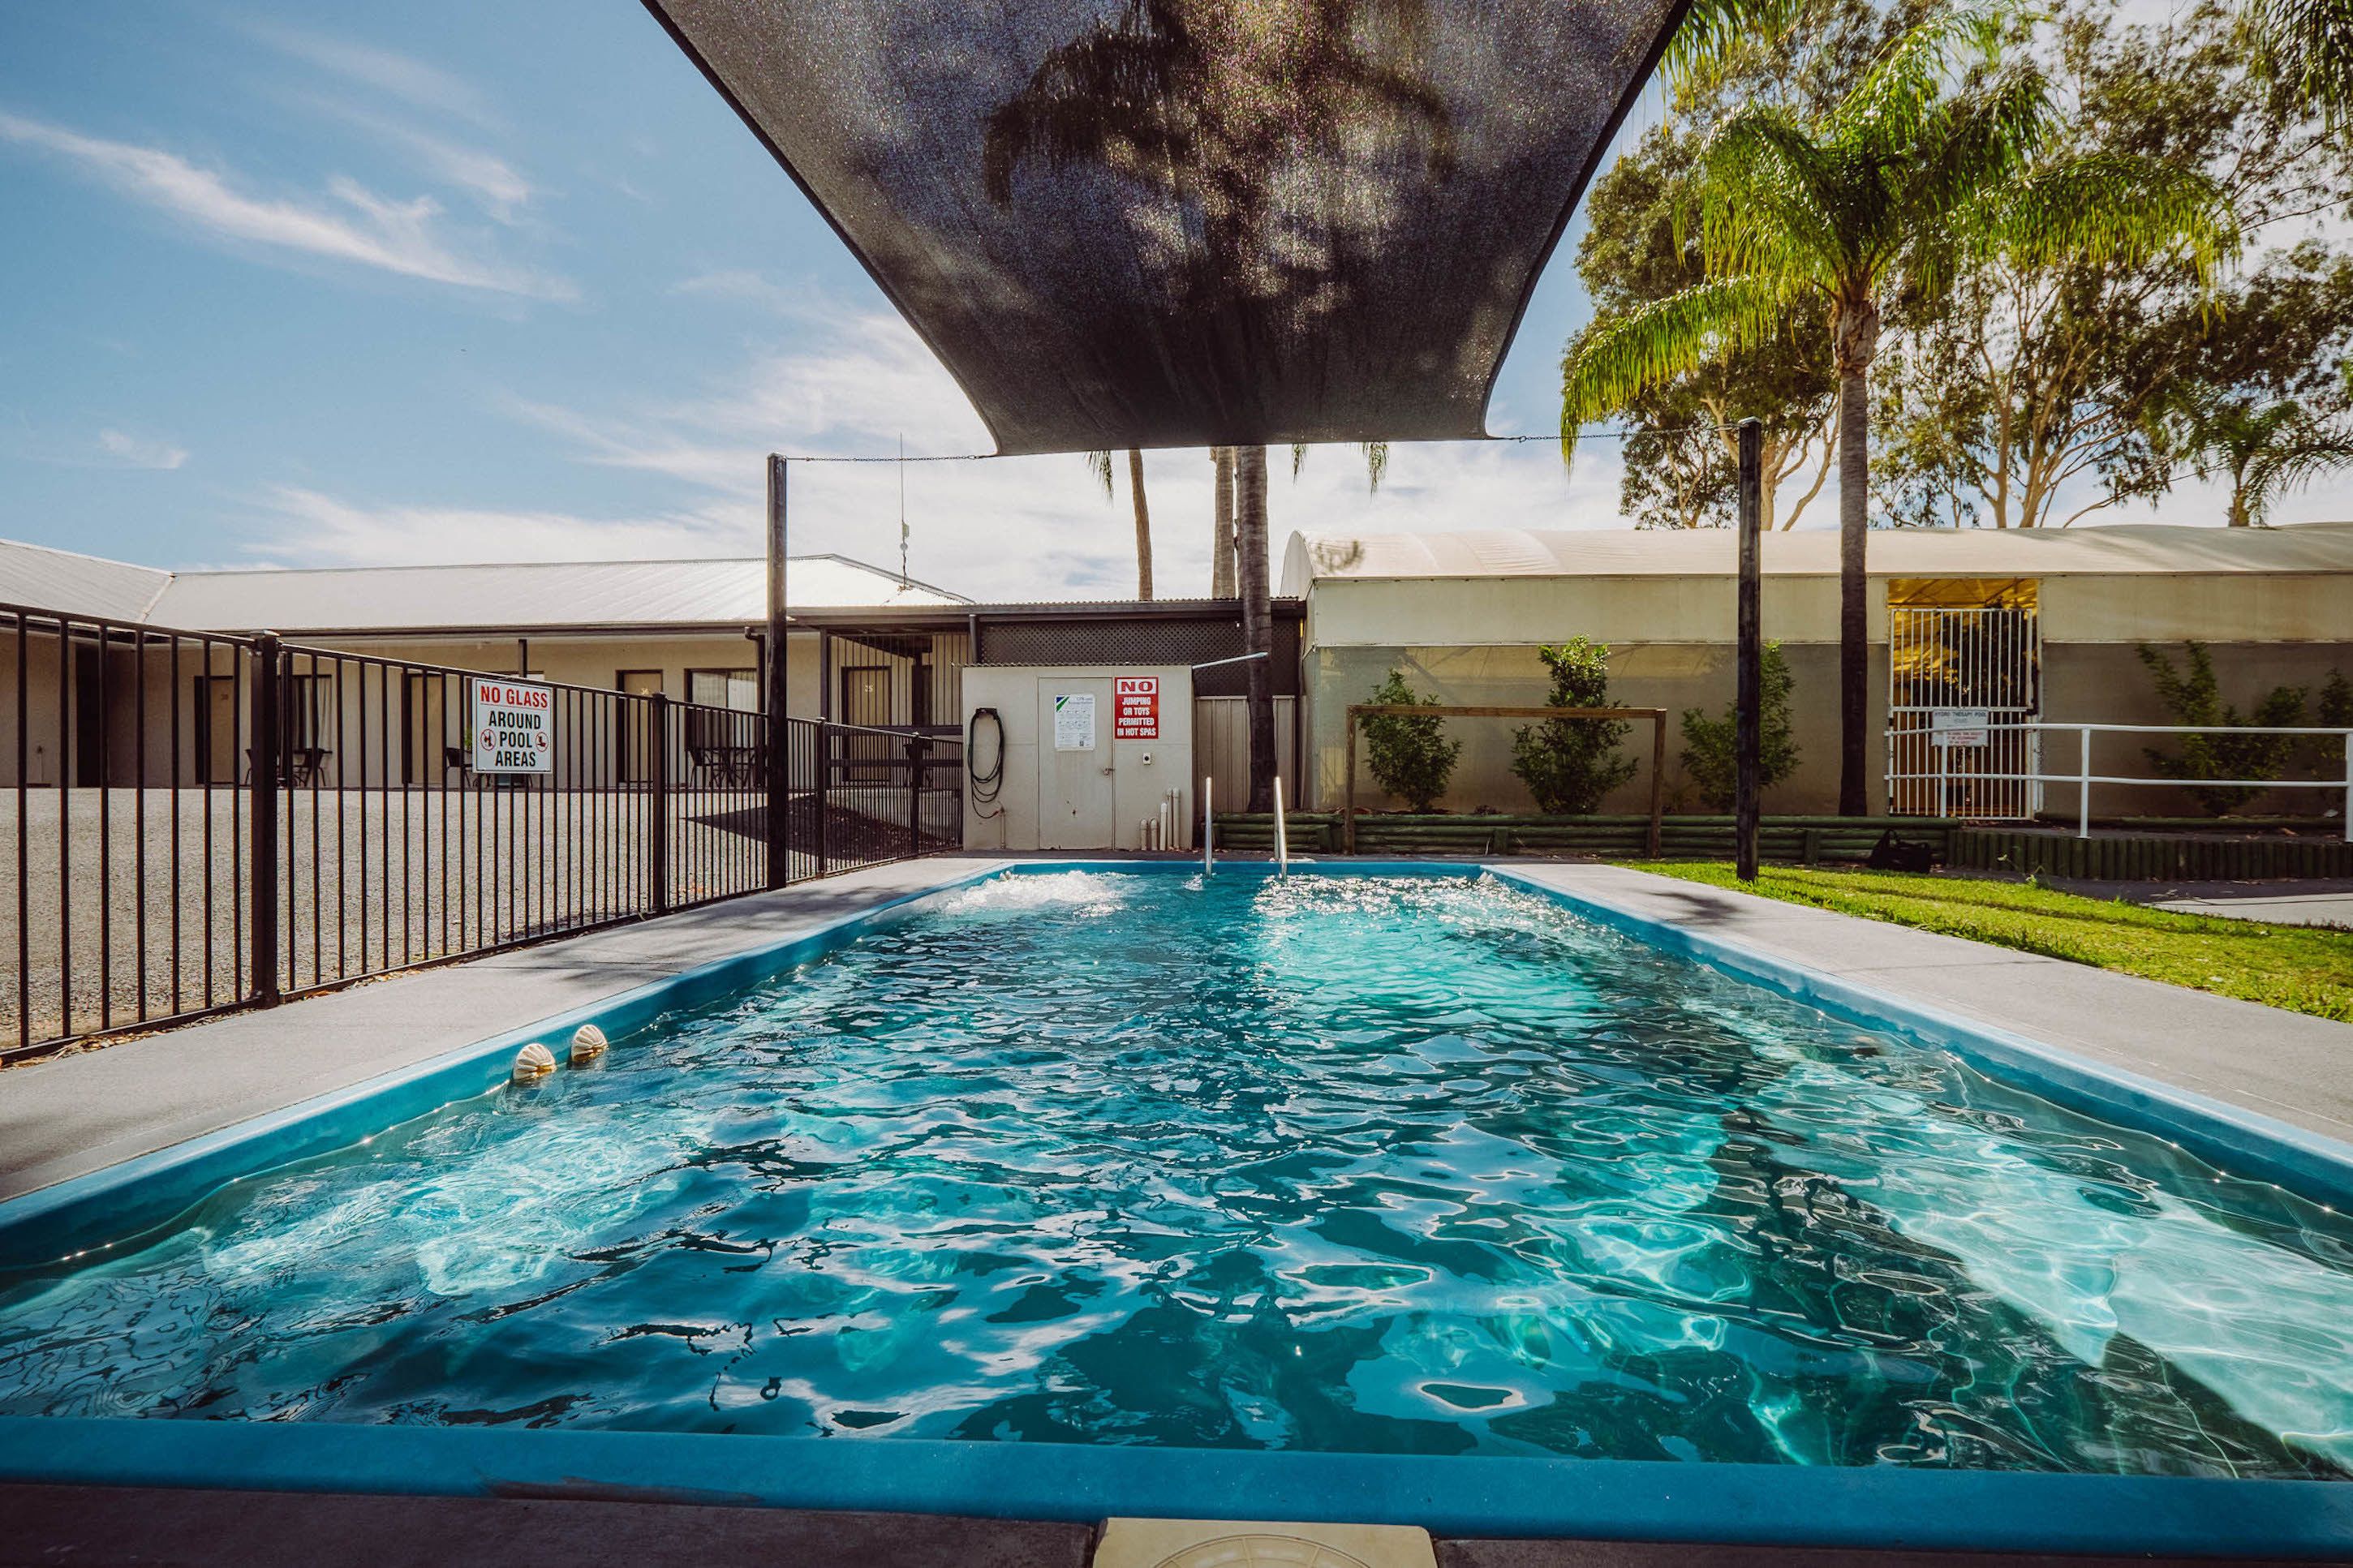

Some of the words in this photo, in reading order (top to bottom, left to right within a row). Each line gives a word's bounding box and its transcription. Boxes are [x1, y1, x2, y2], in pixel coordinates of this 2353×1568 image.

[1121, 681, 1153, 692] NO
[480, 685, 501, 703] NO
[506, 688, 548, 708] GLASS
[1122, 697, 1151, 705] JUMPING
[1123, 707, 1133, 715] OR
[1133, 707, 1151, 715] TOYS
[488, 711, 541, 729] AROUND
[1118, 717, 1155, 725] PERMITTED
[1125, 728, 1139, 736] HOT
[1140, 728, 1156, 736] SPAS
[500, 731, 532, 748] POOL
[495, 750, 536, 767] AREAS
